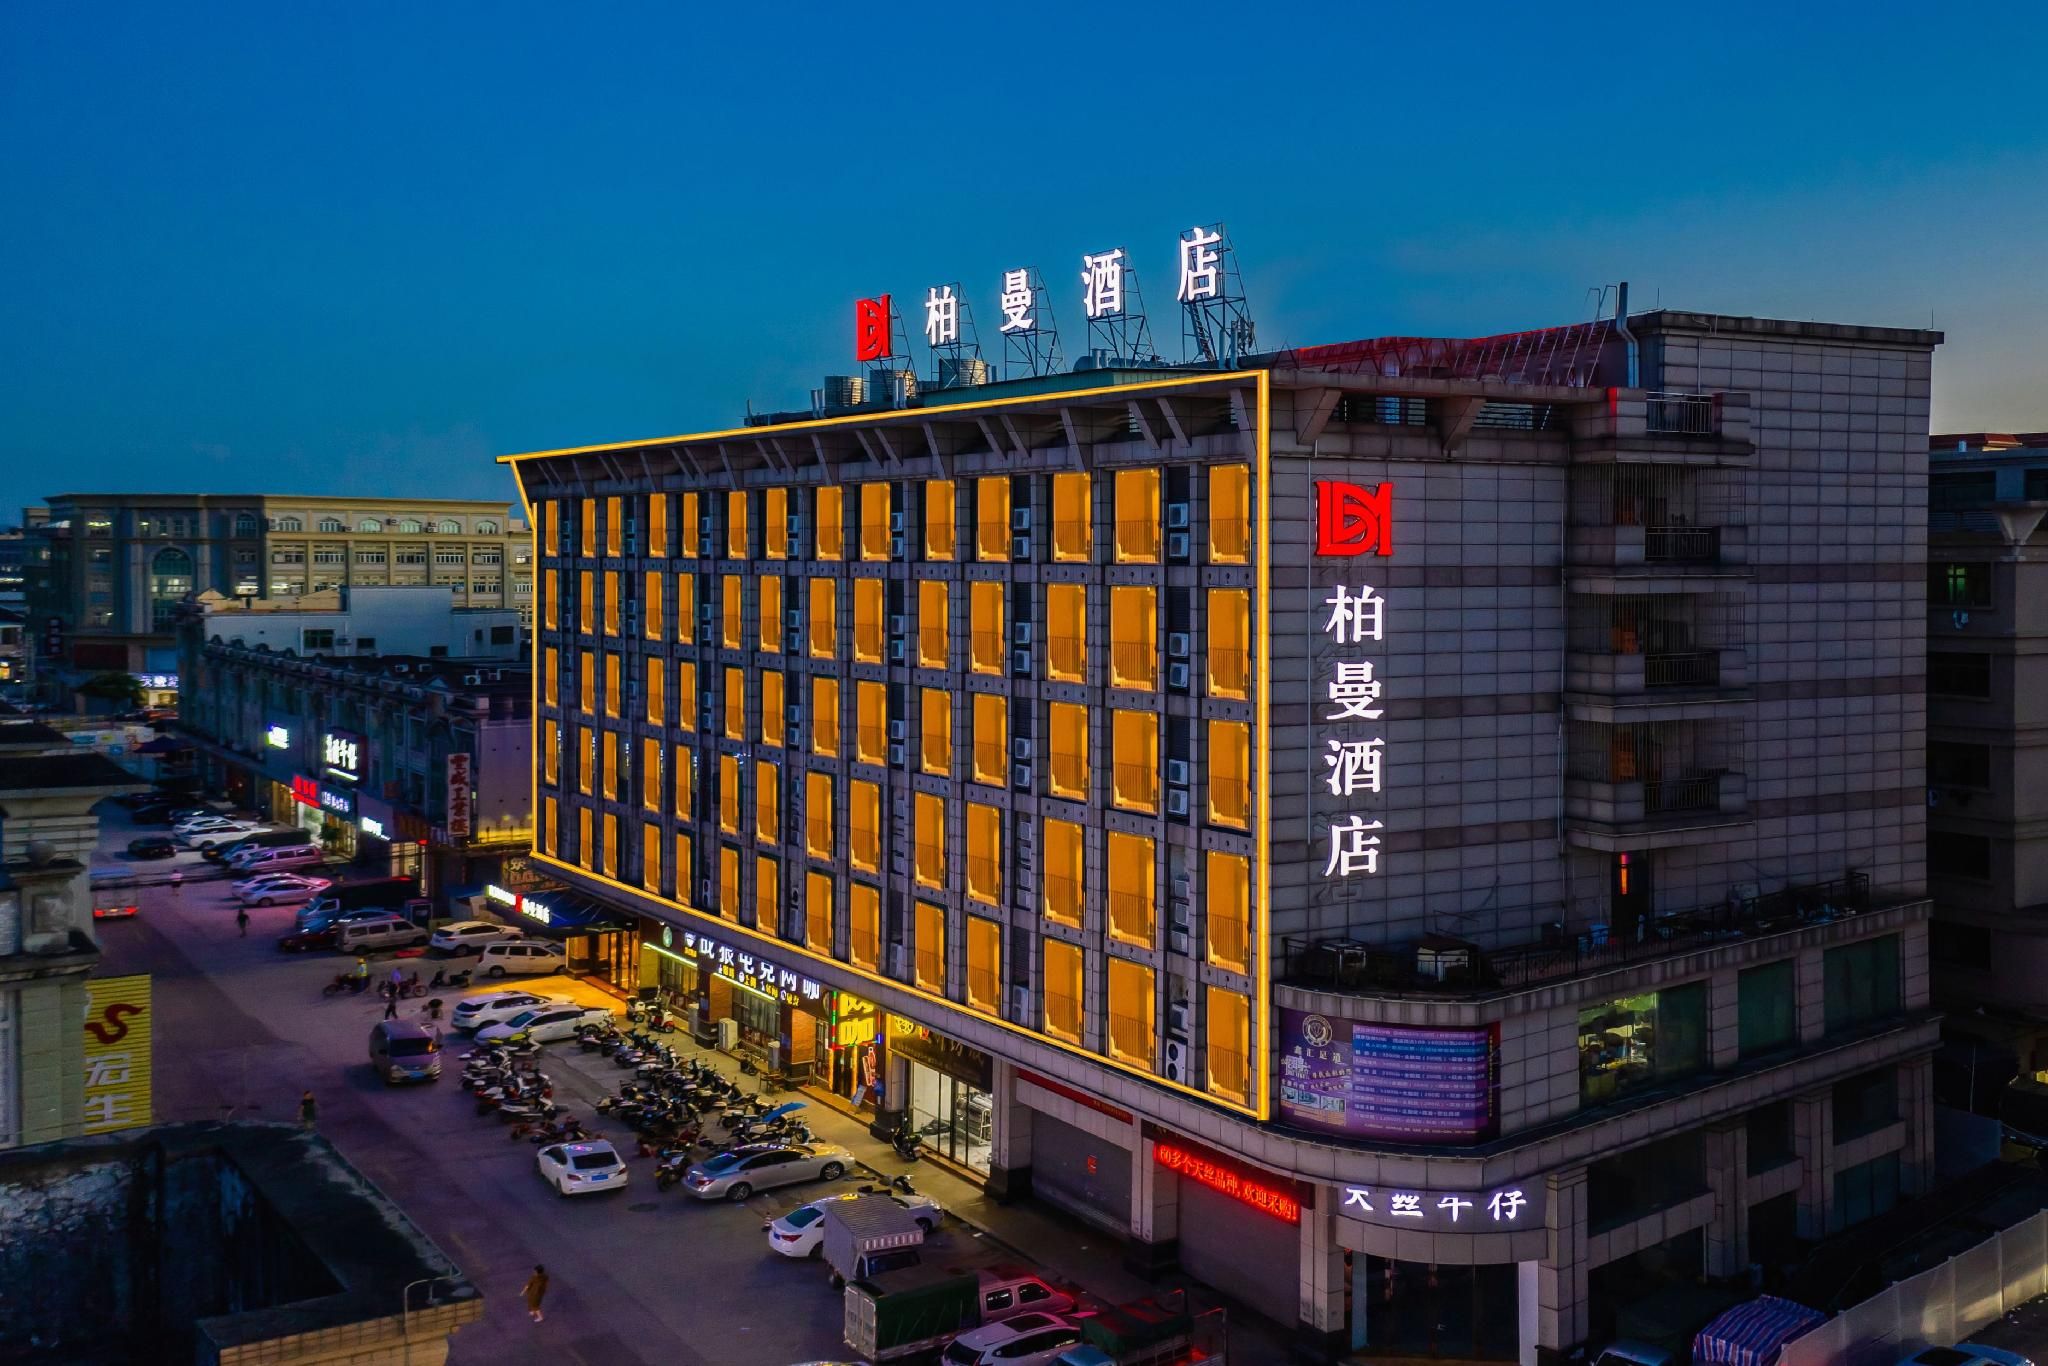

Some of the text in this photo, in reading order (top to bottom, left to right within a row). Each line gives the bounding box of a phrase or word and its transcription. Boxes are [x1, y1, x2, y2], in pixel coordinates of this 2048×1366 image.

[925, 227, 1222, 346] 柏曼酒店
[1324, 584, 1385, 877] 柏曼酒店
